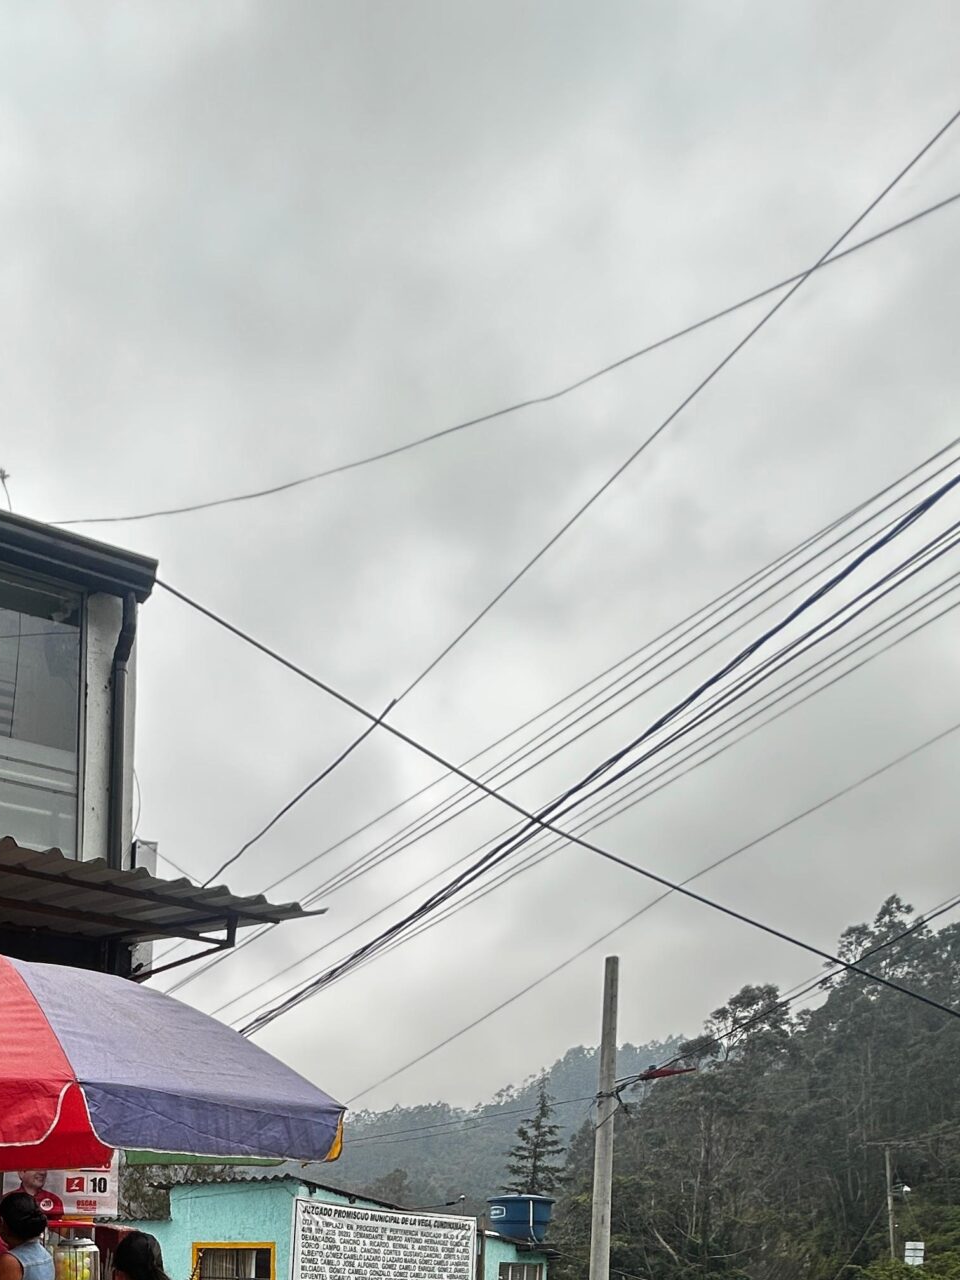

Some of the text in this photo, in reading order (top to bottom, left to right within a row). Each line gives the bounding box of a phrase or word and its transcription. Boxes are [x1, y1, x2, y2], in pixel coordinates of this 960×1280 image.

[90, 1177, 107, 1193] 10
[333, 1209, 369, 1221] PROMISCUO
[370, 1213, 400, 1224] MUNICIPAL
